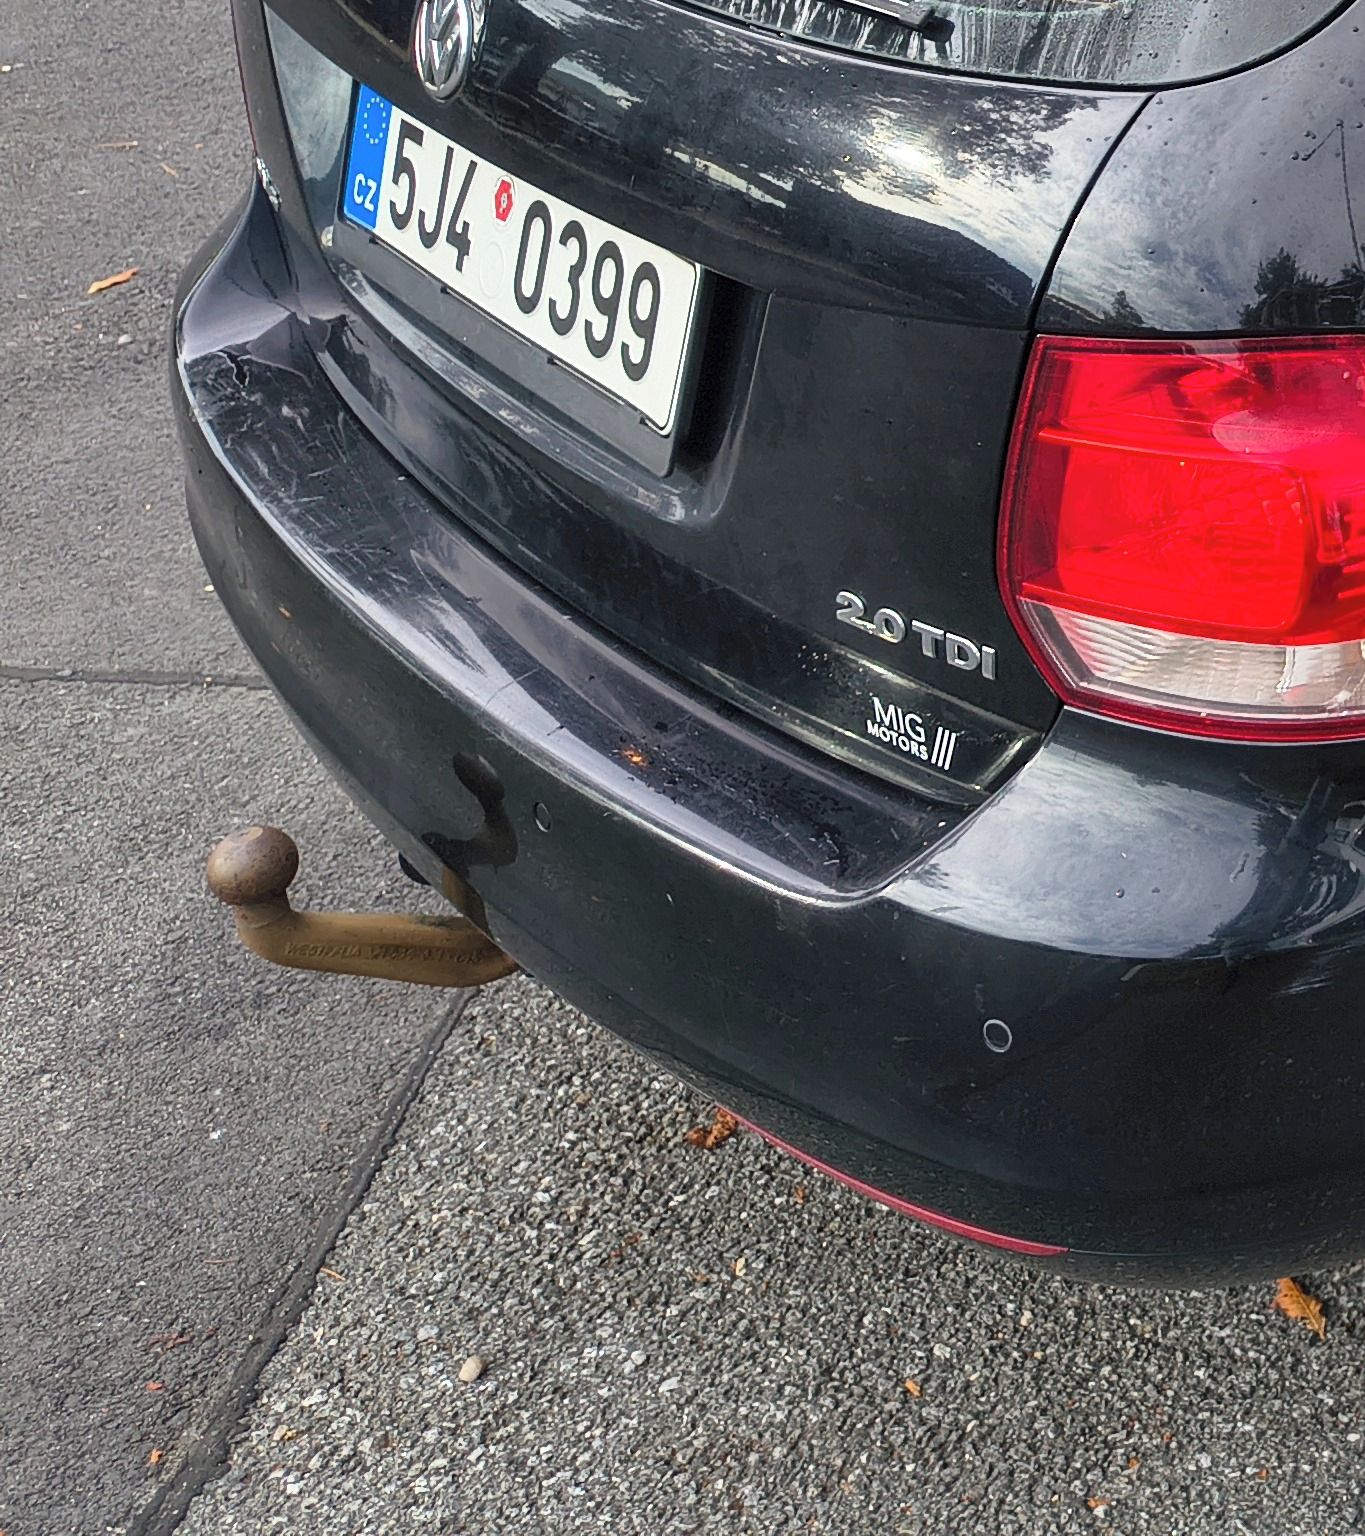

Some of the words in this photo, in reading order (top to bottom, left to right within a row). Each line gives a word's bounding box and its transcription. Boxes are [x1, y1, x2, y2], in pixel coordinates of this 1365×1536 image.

[353, 173, 378, 212] CZ
[389, 118, 477, 273] 5J4
[514, 200, 662, 382] 0399
[835, 590, 906, 644] 2.0
[911, 619, 997, 681] TDI
[866, 719, 930, 761] MOTORS
[871, 696, 926, 743] MIG
